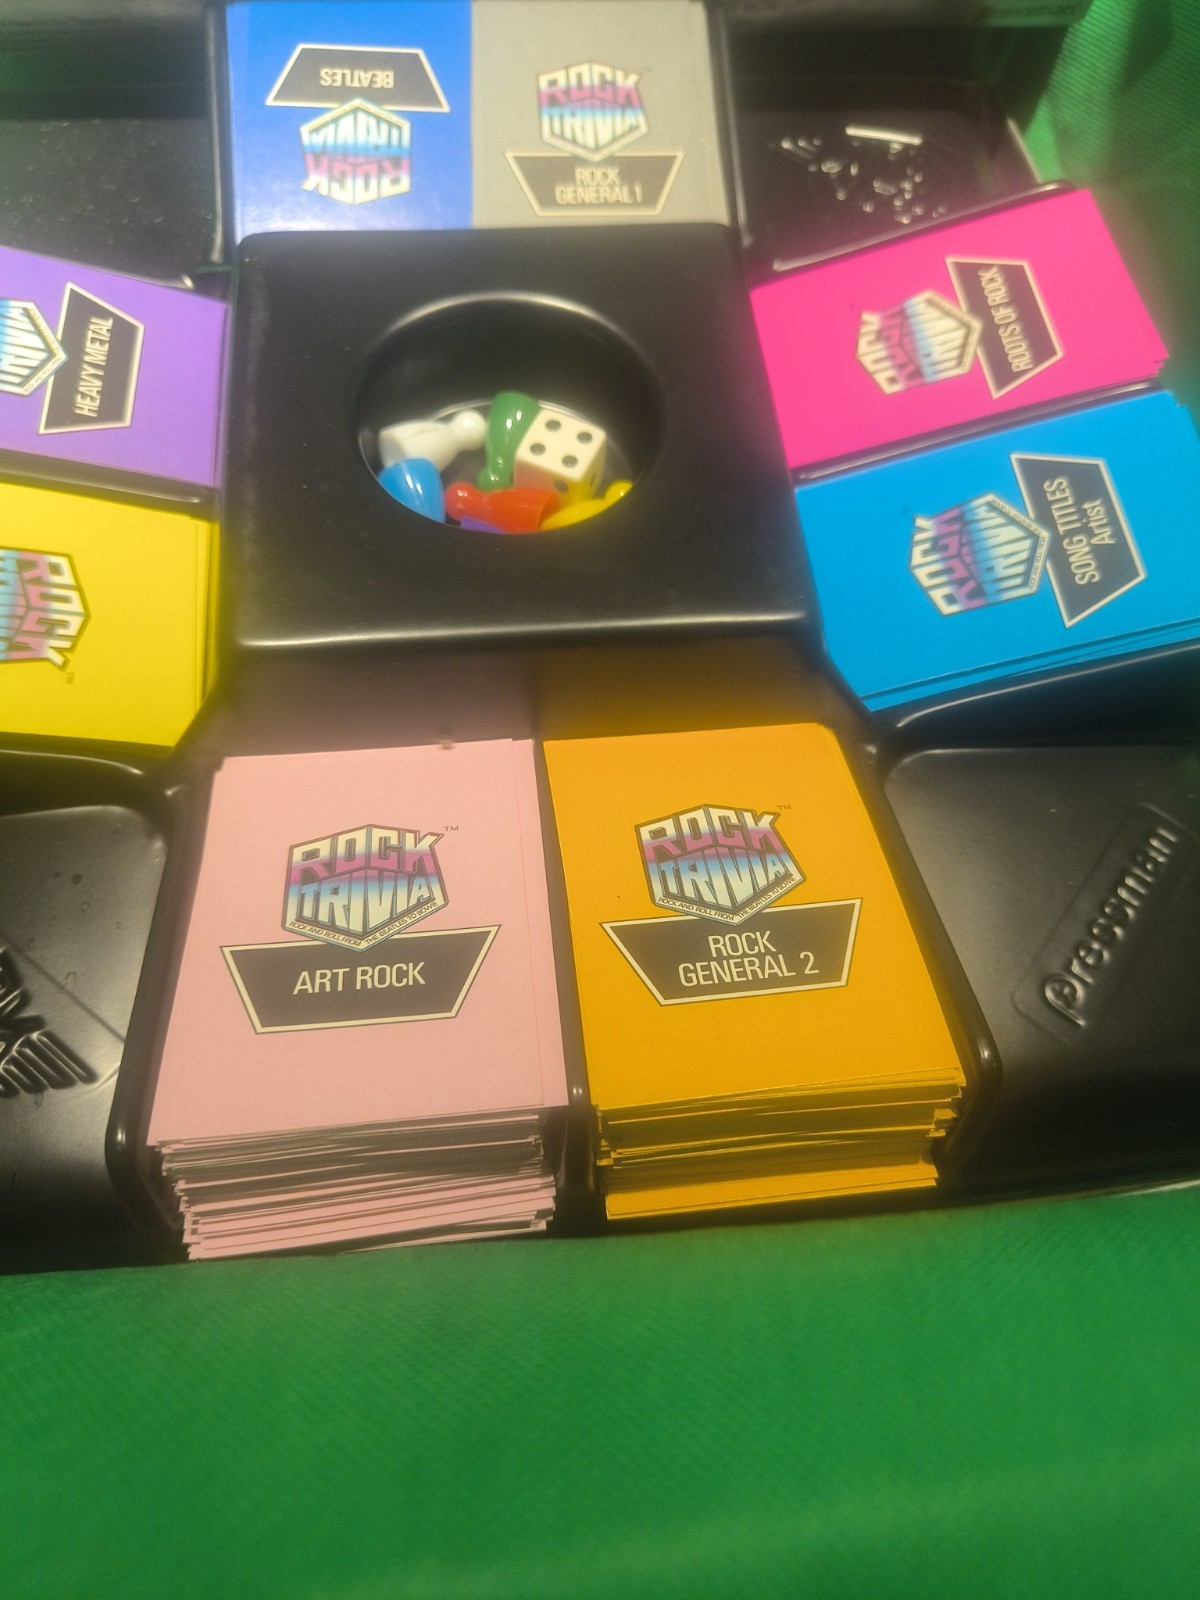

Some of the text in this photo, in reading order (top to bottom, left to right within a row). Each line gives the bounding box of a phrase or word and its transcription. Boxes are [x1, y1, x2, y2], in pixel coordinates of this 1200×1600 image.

[319, 67, 395, 89] BEATLES
[538, 62, 641, 108] ROCK
[547, 99, 641, 150] TRIVIA
[301, 153, 411, 205] ROCK
[555, 183, 643, 205] GENERAL 1
[574, 165, 621, 187] ROCK
[978, 264, 1033, 373] ROOTS OF ROCK
[74, 316, 113, 417] HEAVY METAL
[857, 304, 926, 395] ROCK
[961, 503, 1032, 592] TRIVIA
[1043, 476, 1099, 585] SONG TITLES
[1081, 498, 1116, 545] Artist
[909, 507, 987, 616] ROCK
[8, 553, 91, 671] ROCK
[289, 824, 444, 886] ROCK
[634, 804, 781, 863] ROCK
[300, 868, 436, 934] TRIVIA
[656, 846, 792, 910] TRIVIA
[288, 920, 362, 947] ROCK AND ROLL FROM
[364, 934, 379, 945] THE
[378, 918, 408, 937] BEATLES
[406, 913, 417, 921] TO
[658, 897, 735, 921] ROCK AND ROLL FROM
[1043, 827, 1178, 1028] Pressman
[677, 951, 819, 987] GENERAL 2
[707, 930, 777, 958] ROCK
[292, 961, 426, 996] ART ROCK
